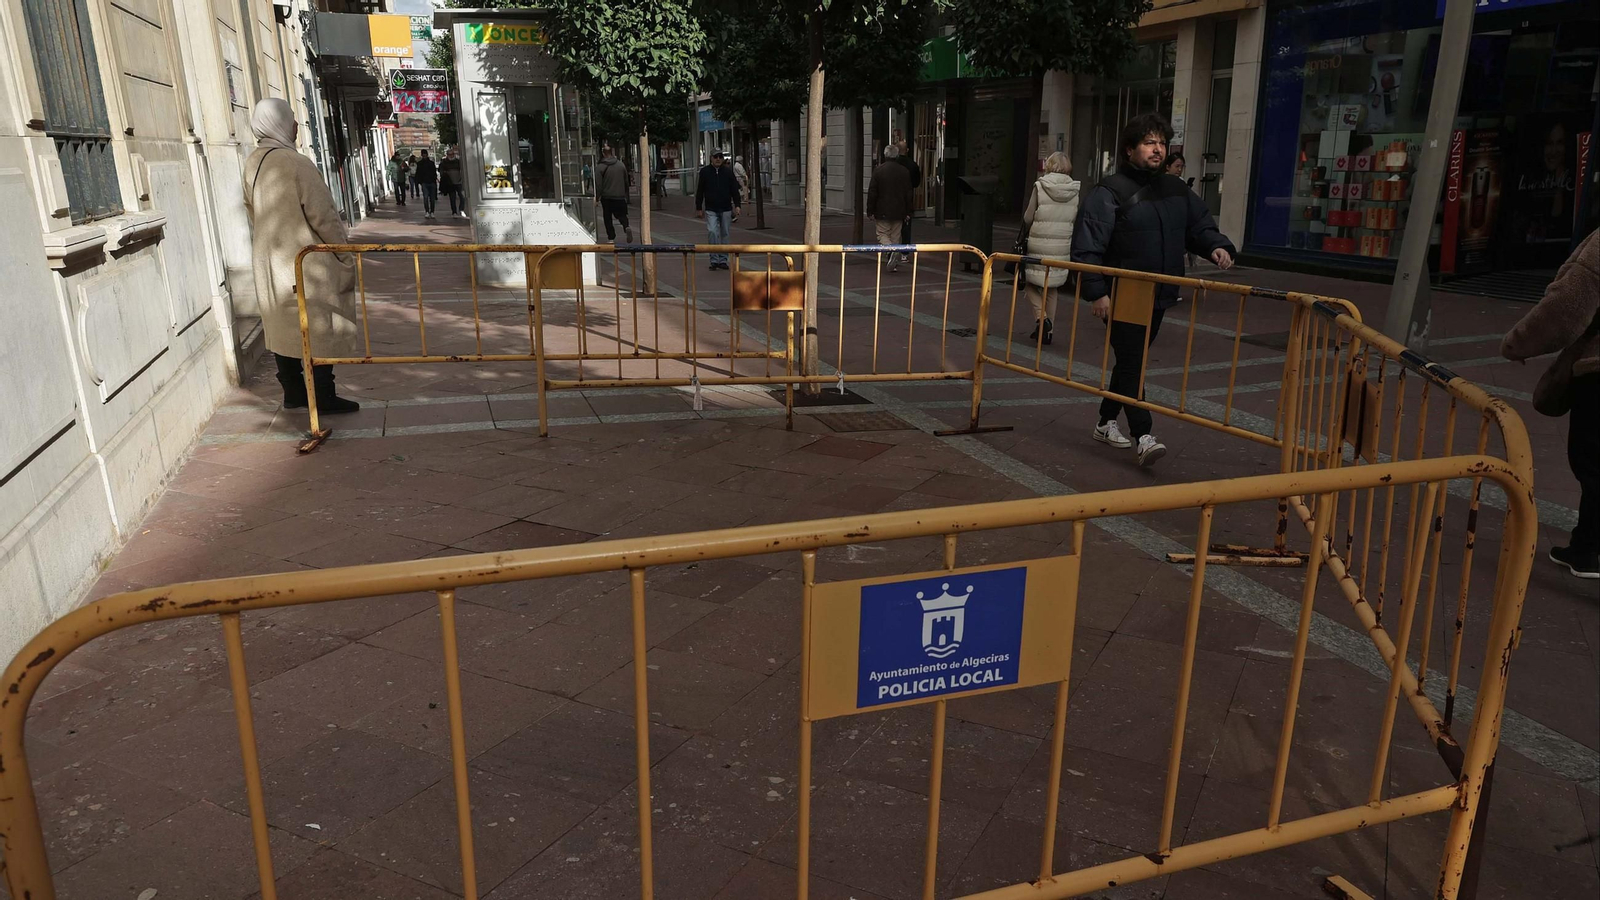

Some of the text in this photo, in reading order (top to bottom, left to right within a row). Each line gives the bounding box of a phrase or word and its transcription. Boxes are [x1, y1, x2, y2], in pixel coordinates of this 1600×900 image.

[490, 27, 540, 42] ONCE
[374, 46, 409, 56] orange
[406, 74, 446, 82] SESHAT CBD
[1447, 130, 1464, 203] CLARINS
[869, 652, 1010, 681] Ayuntamiento de Algeciras
[878, 668, 1003, 699] POLICIA LOCAL
